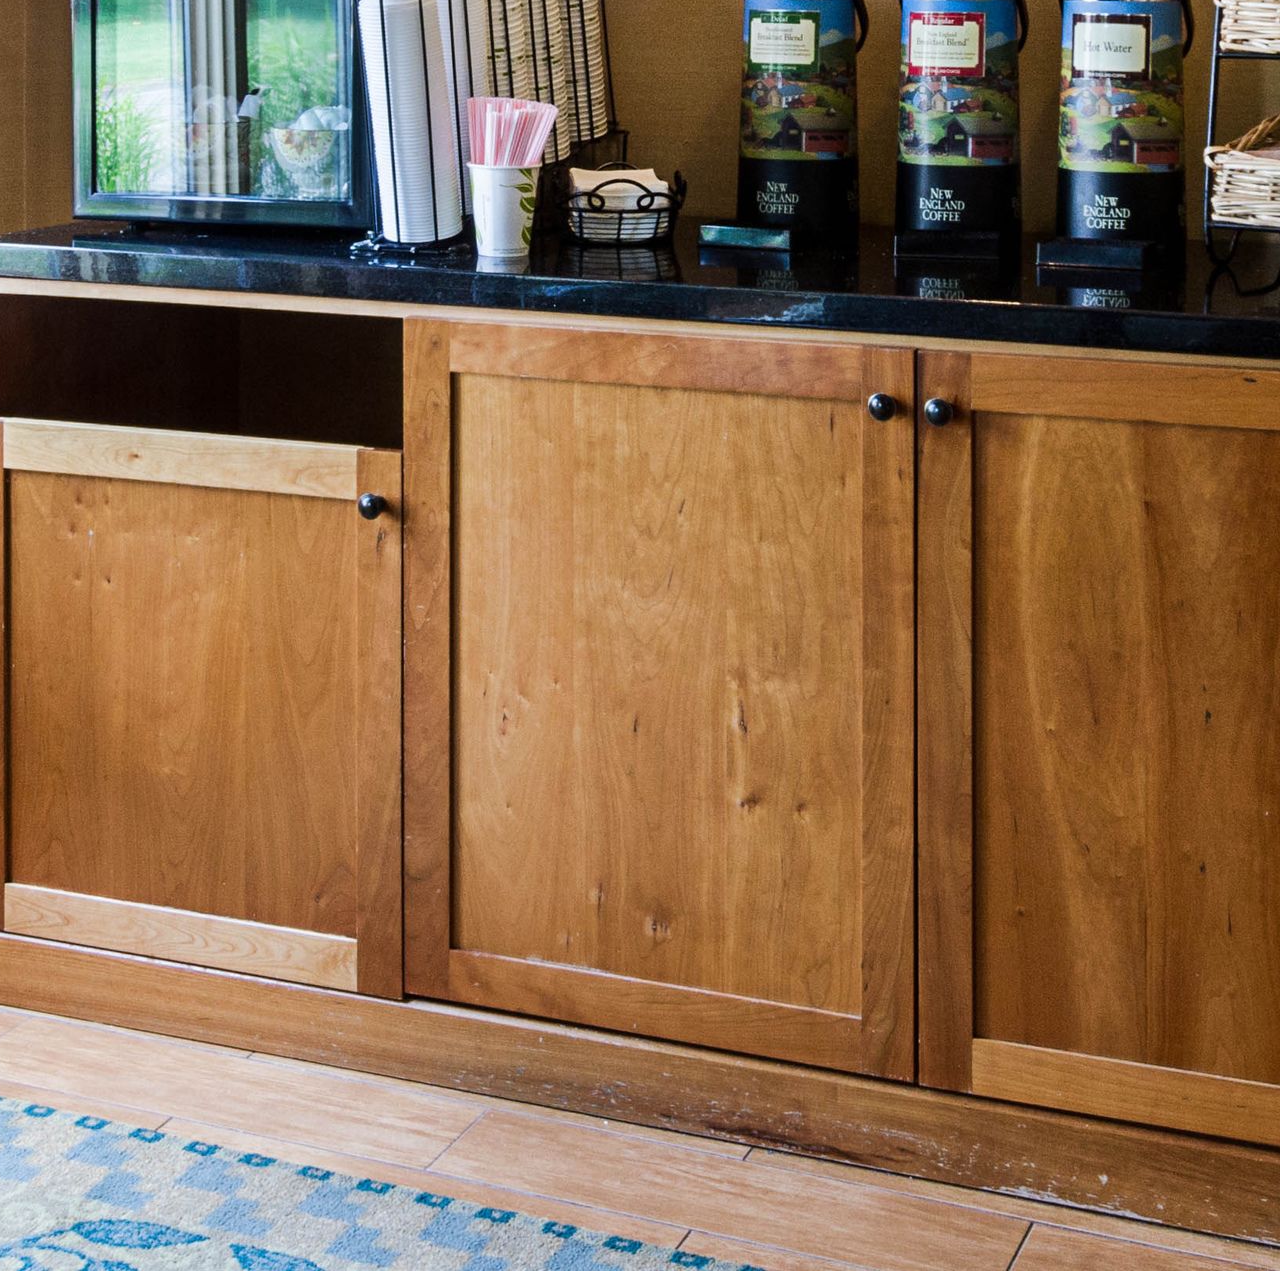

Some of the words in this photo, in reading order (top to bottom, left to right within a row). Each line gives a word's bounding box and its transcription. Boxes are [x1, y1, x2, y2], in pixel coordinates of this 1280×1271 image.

[784, 33, 804, 42] Blend
[1083, 40, 1101, 53] Hot
[1103, 41, 1133, 54] Water
[766, 181, 788, 193] NEW
[930, 187, 955, 199] NEW
[756, 190, 800, 204] ENGLAND
[1094, 194, 1119, 207] NEW
[758, 203, 796, 215] COFFEE
[919, 197, 966, 211] ENGLAND
[922, 209, 961, 222] COFFEE
[1082, 204, 1131, 219] ENGLAND
[1086, 217, 1127, 230] COFFEE
